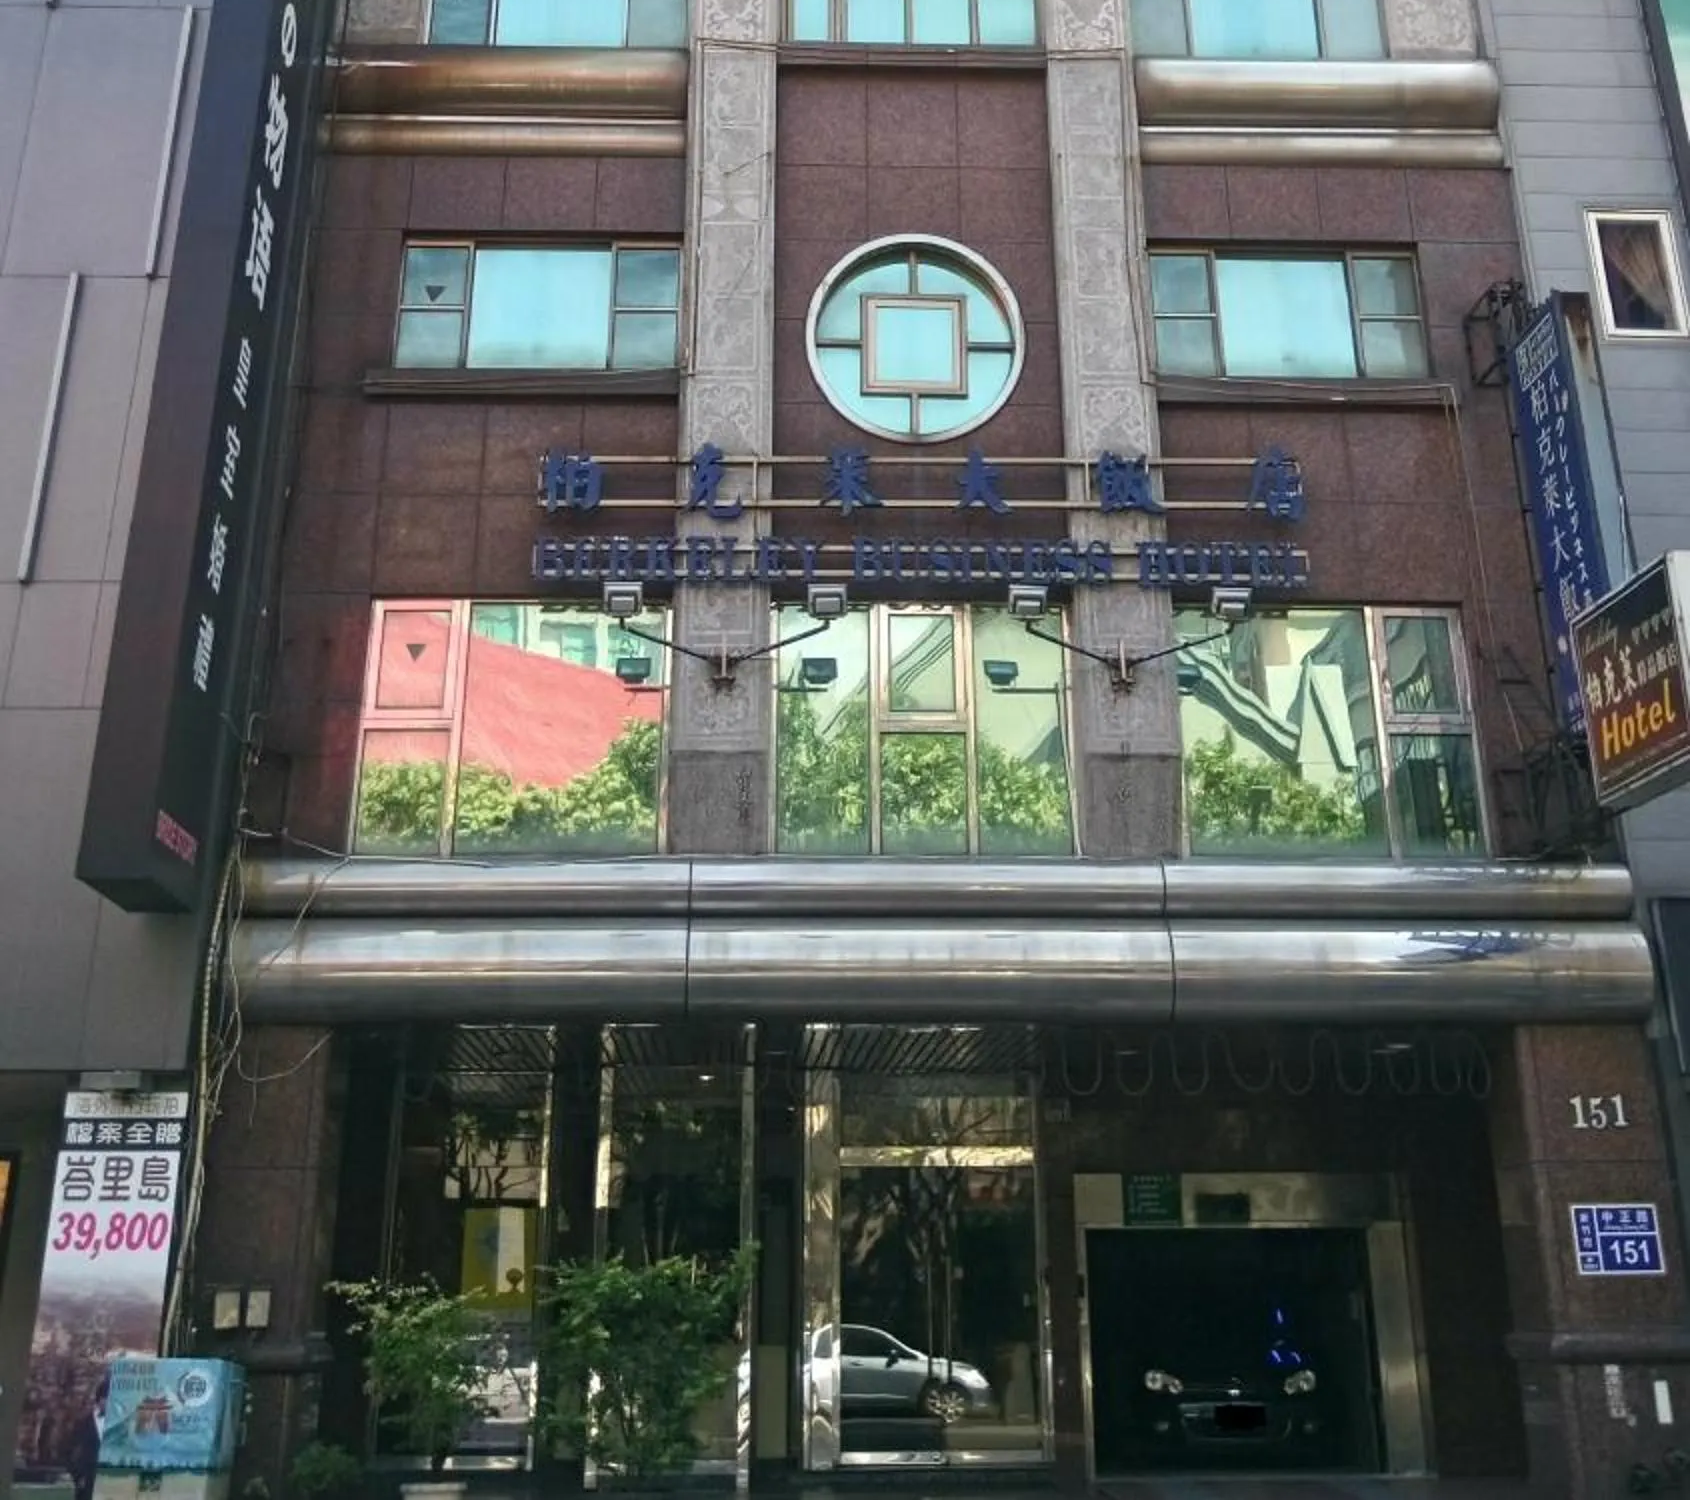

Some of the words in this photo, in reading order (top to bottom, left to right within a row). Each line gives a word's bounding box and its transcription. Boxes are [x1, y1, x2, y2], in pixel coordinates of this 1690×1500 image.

[535, 535, 822, 583] BERKELEY
[853, 535, 1112, 586] BUSINESS
[1136, 538, 1309, 589] HOTEL
[1601, 677, 1677, 760] Hotel
[1568, 1093, 1630, 1130] 151
[66, 1121, 181, 1145] 檔案全贈
[61, 1155, 172, 1202] 峇里島
[53, 1212, 169, 1260] 39,800
[1601, 1209, 1649, 1224] 中正路
[1609, 1240, 1650, 1265] 151
